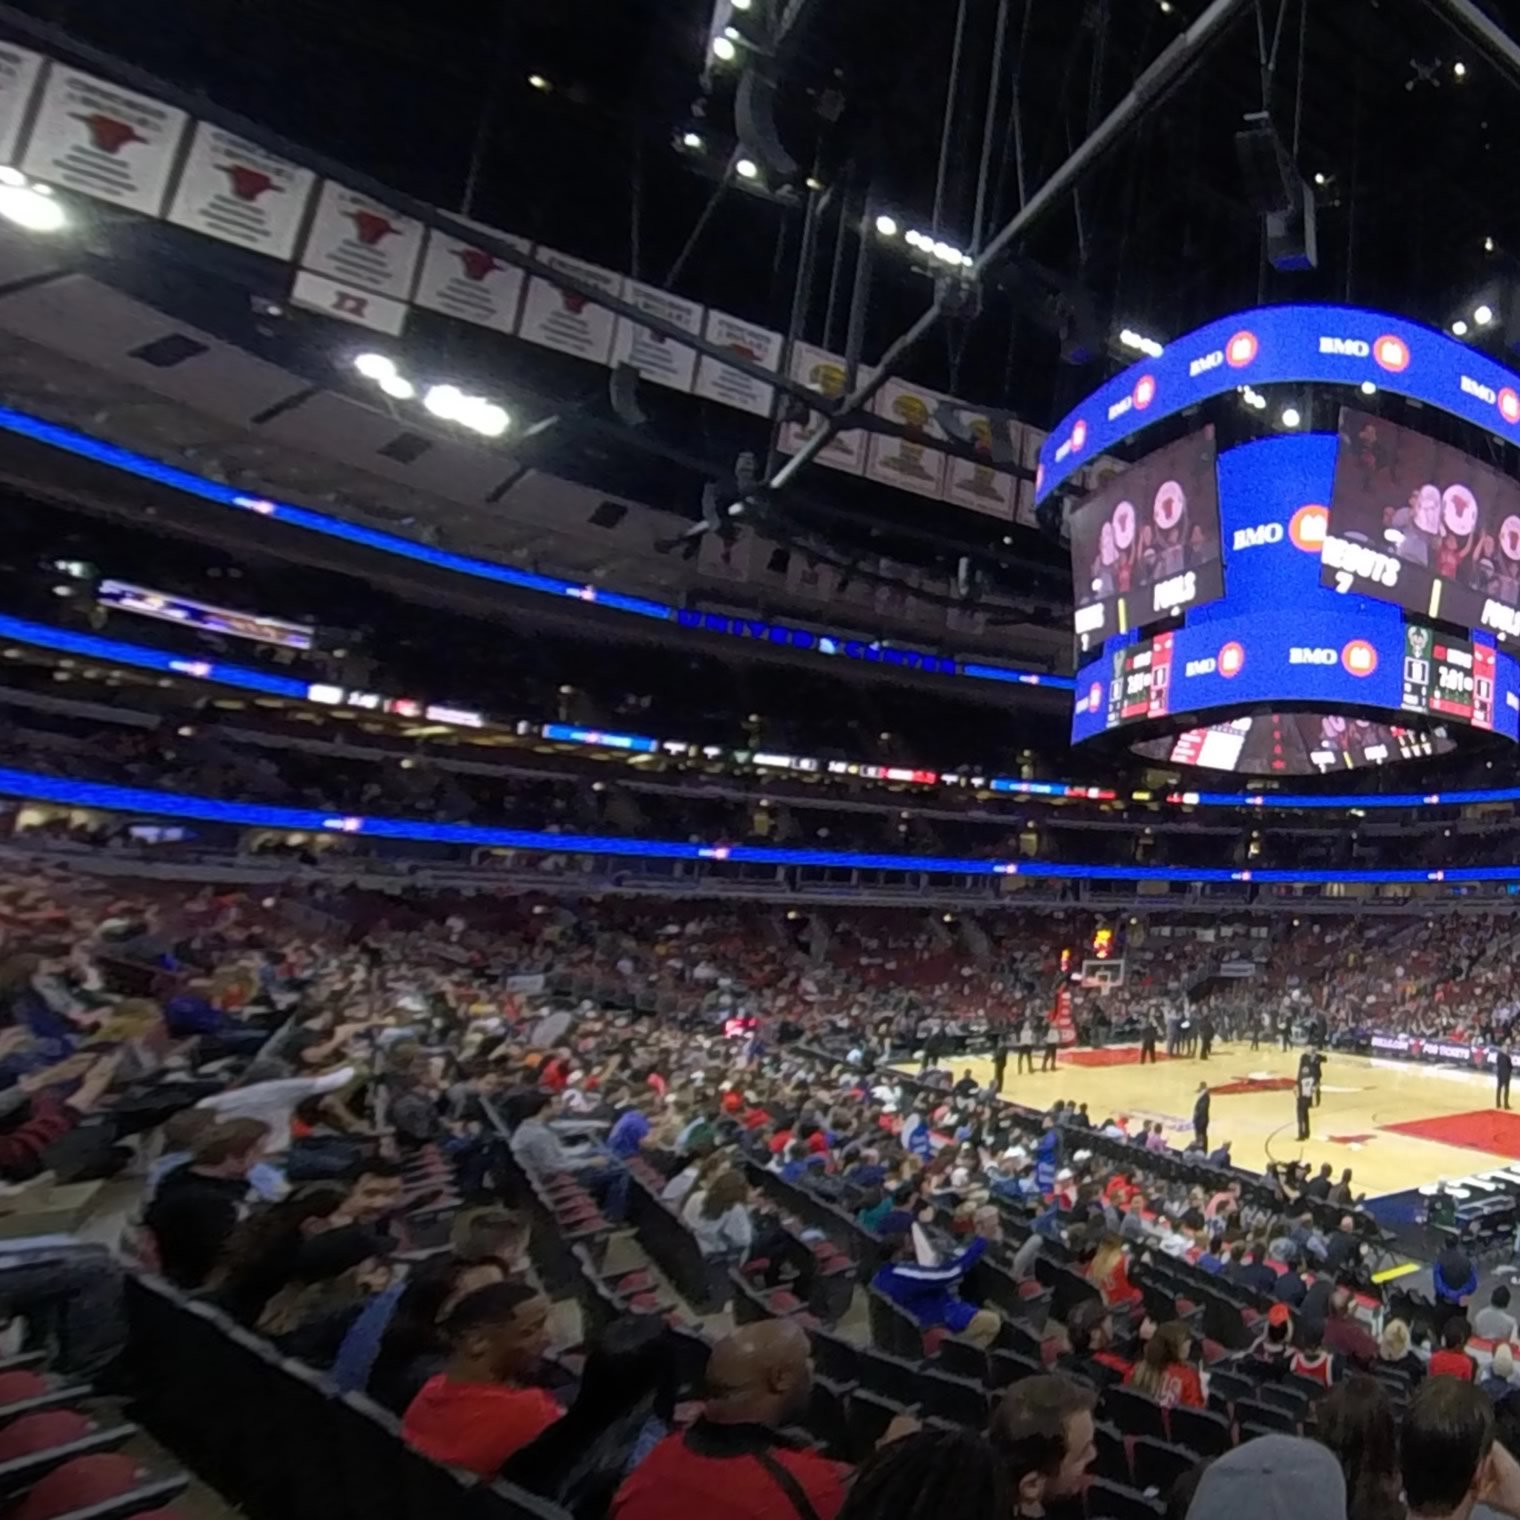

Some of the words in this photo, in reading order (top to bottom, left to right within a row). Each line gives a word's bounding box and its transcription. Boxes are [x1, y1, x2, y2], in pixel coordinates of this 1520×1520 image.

[1319, 336, 1370, 357] BMO
[1190, 350, 1224, 377] BMO
[1460, 375, 1496, 405] BMO
[1232, 523, 1284, 551] BMO
[678, 608, 813, 648] UNITED
[1185, 657, 1217, 677] BMO
[1289, 647, 1338, 665] BMO
